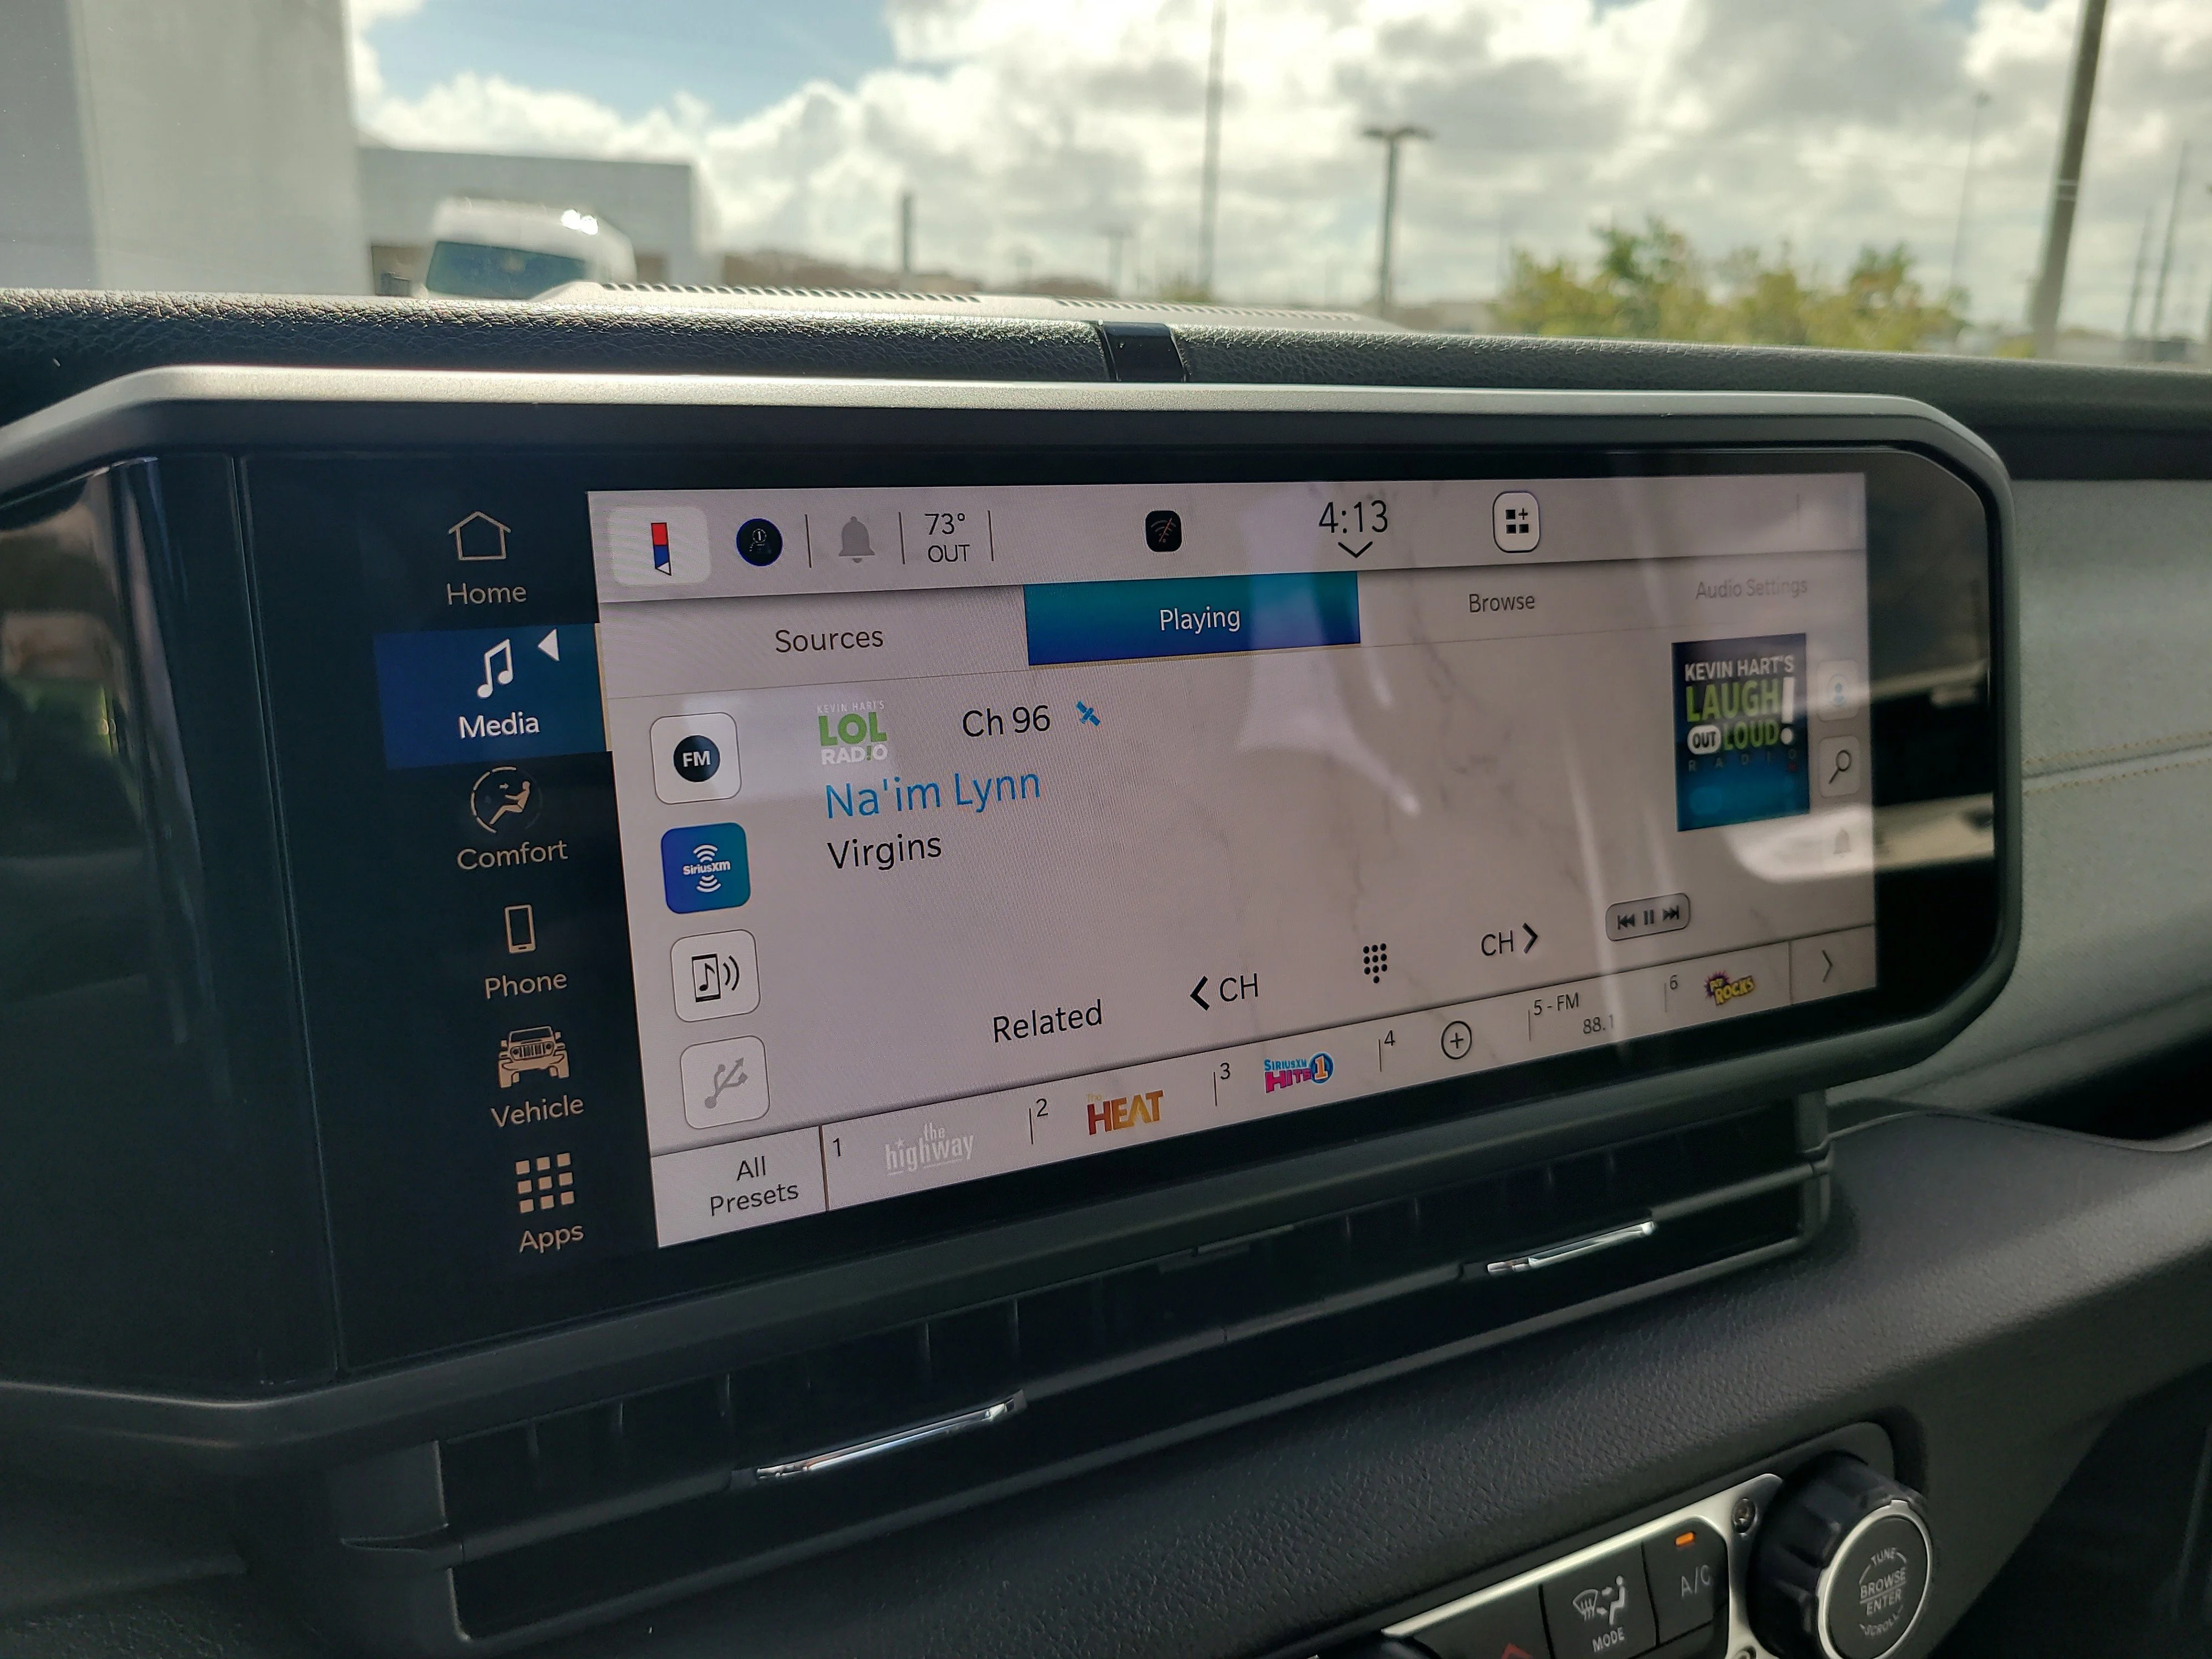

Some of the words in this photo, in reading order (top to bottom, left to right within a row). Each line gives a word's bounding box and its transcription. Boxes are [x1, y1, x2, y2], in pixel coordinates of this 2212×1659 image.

[1318, 499, 1389, 534] 4:13
[928, 544, 970, 562] OUT
[447, 583, 527, 605] Home
[1695, 579, 1742, 600] Audio
[1746, 578, 1808, 598] Settings
[1469, 593, 1536, 613] Browse
[1159, 606, 1240, 634] Playing
[775, 629, 884, 653] Sources
[1685, 661, 1734, 681] KEVIN
[1737, 654, 1795, 676] HART'S
[817, 703, 848, 714] KEVIN
[962, 708, 1004, 737] Ch
[1013, 705, 1051, 732] 96
[459, 712, 540, 739] Media
[819, 712, 887, 746] LOL
[1692, 731, 1716, 749] OUT
[682, 752, 711, 766] FM
[826, 776, 941, 819] Na'im
[954, 772, 1041, 813] Lynn
[458, 841, 568, 870] Comfort
[827, 833, 942, 871] Virgins
[1481, 930, 1514, 956] CH
[484, 972, 568, 999] Phone
[1219, 973, 1259, 1002] CH
[1669, 975, 1678, 990] 6
[1534, 1000, 1542, 1015] 5
[1557, 992, 1579, 1011] FM
[993, 999, 1102, 1042] Related
[1583, 1014, 1613, 1034] 88.1
[1384, 1030, 1396, 1046] 4
[1220, 1063, 1231, 1080] 3
[1315, 1056, 1328, 1080] 1
[491, 1096, 585, 1127] Vehicle
[1036, 1098, 1048, 1117] 2
[1087, 1090, 1164, 1136] HEAT
[924, 1122, 946, 1141] the
[833, 1138, 841, 1156] 1
[885, 1135, 974, 1172] highway
[737, 1156, 766, 1181] All
[710, 1183, 799, 1216] Presets
[520, 1224, 585, 1253] Apps
[1871, 1547, 1897, 1567] TUNE
[1680, 1565, 1711, 1598] A/C
[1860, 1567, 1906, 1599] BROWSE
[1866, 1589, 1901, 1616] ENTER
[1592, 1627, 1626, 1652] MODE
